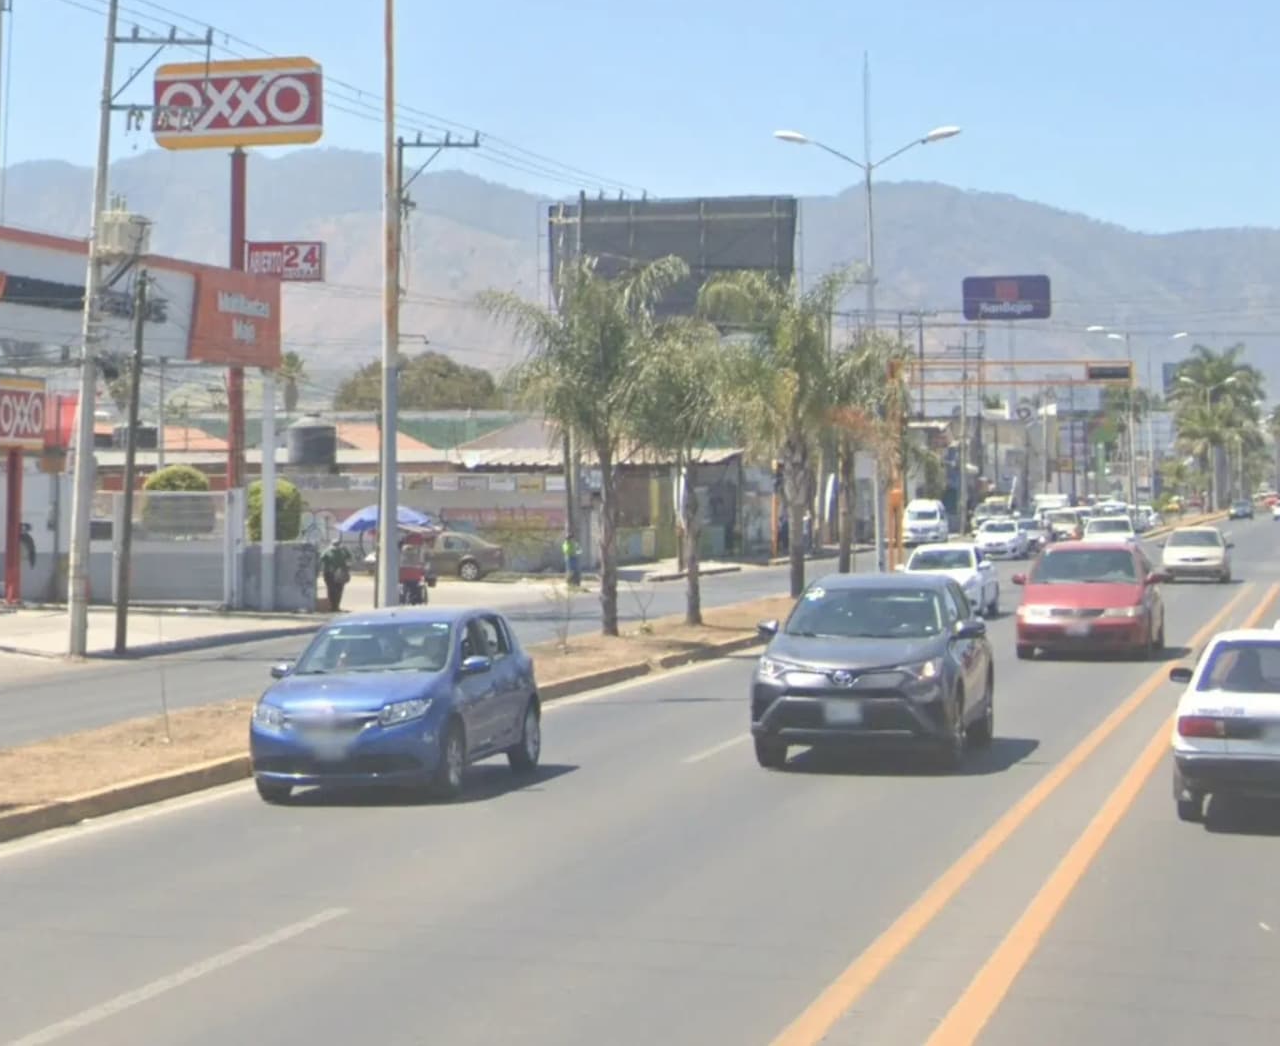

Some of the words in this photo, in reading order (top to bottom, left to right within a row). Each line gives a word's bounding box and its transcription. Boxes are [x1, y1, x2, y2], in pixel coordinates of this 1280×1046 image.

[157, 73, 311, 132] OXXO
[283, 245, 318, 268] 24
[0, 392, 43, 437] OXXO
